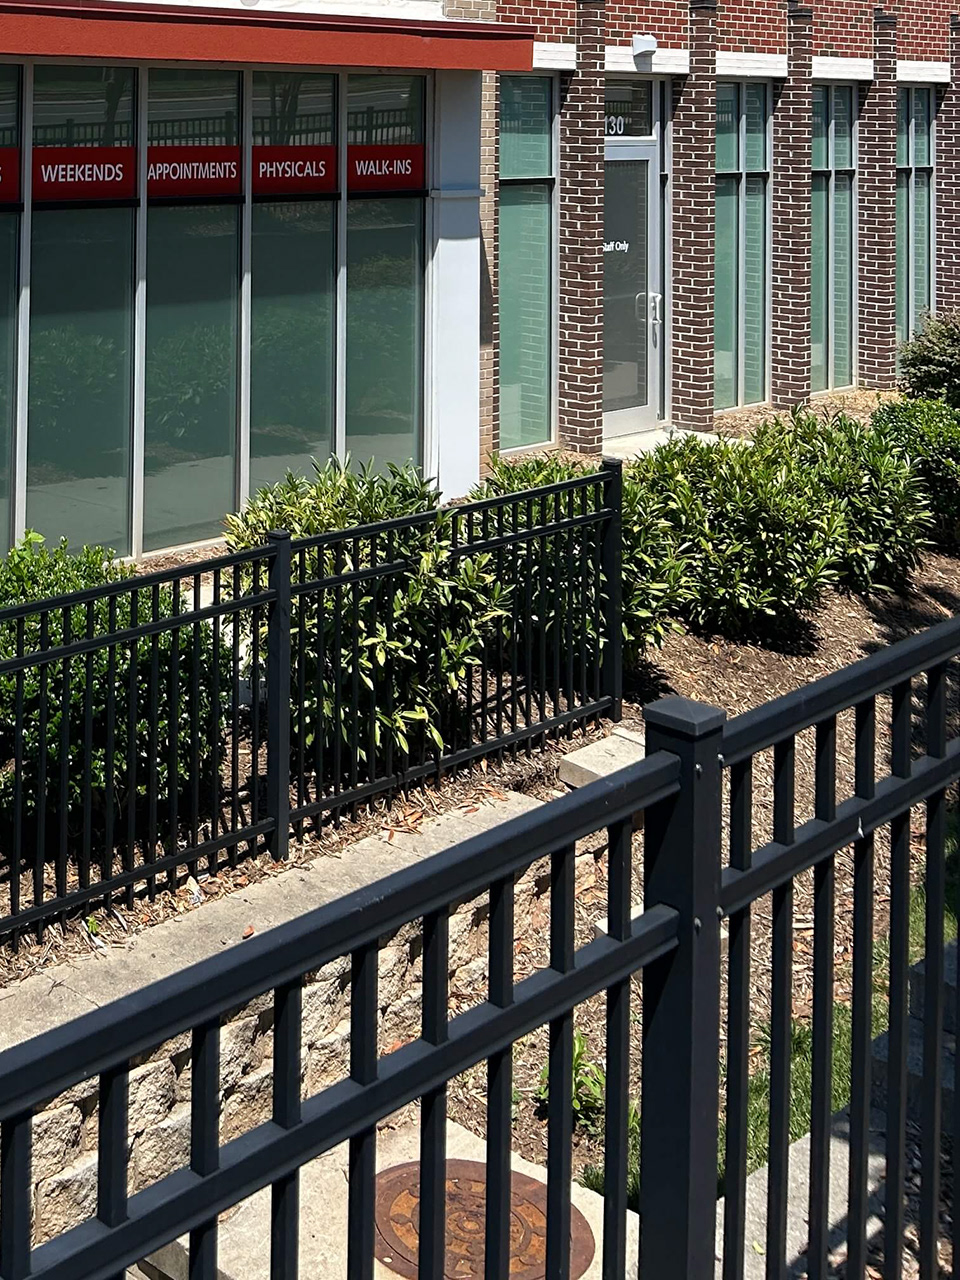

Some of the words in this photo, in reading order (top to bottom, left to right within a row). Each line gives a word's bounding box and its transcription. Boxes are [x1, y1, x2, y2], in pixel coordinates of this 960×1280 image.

[40, 163, 123, 182] WEEKENDS
[147, 161, 237, 180] APPOINTMENTS
[258, 160, 326, 178] PHYSICALS
[355, 158, 412, 176] WALK-INS
[615, 240, 629, 253] Only
